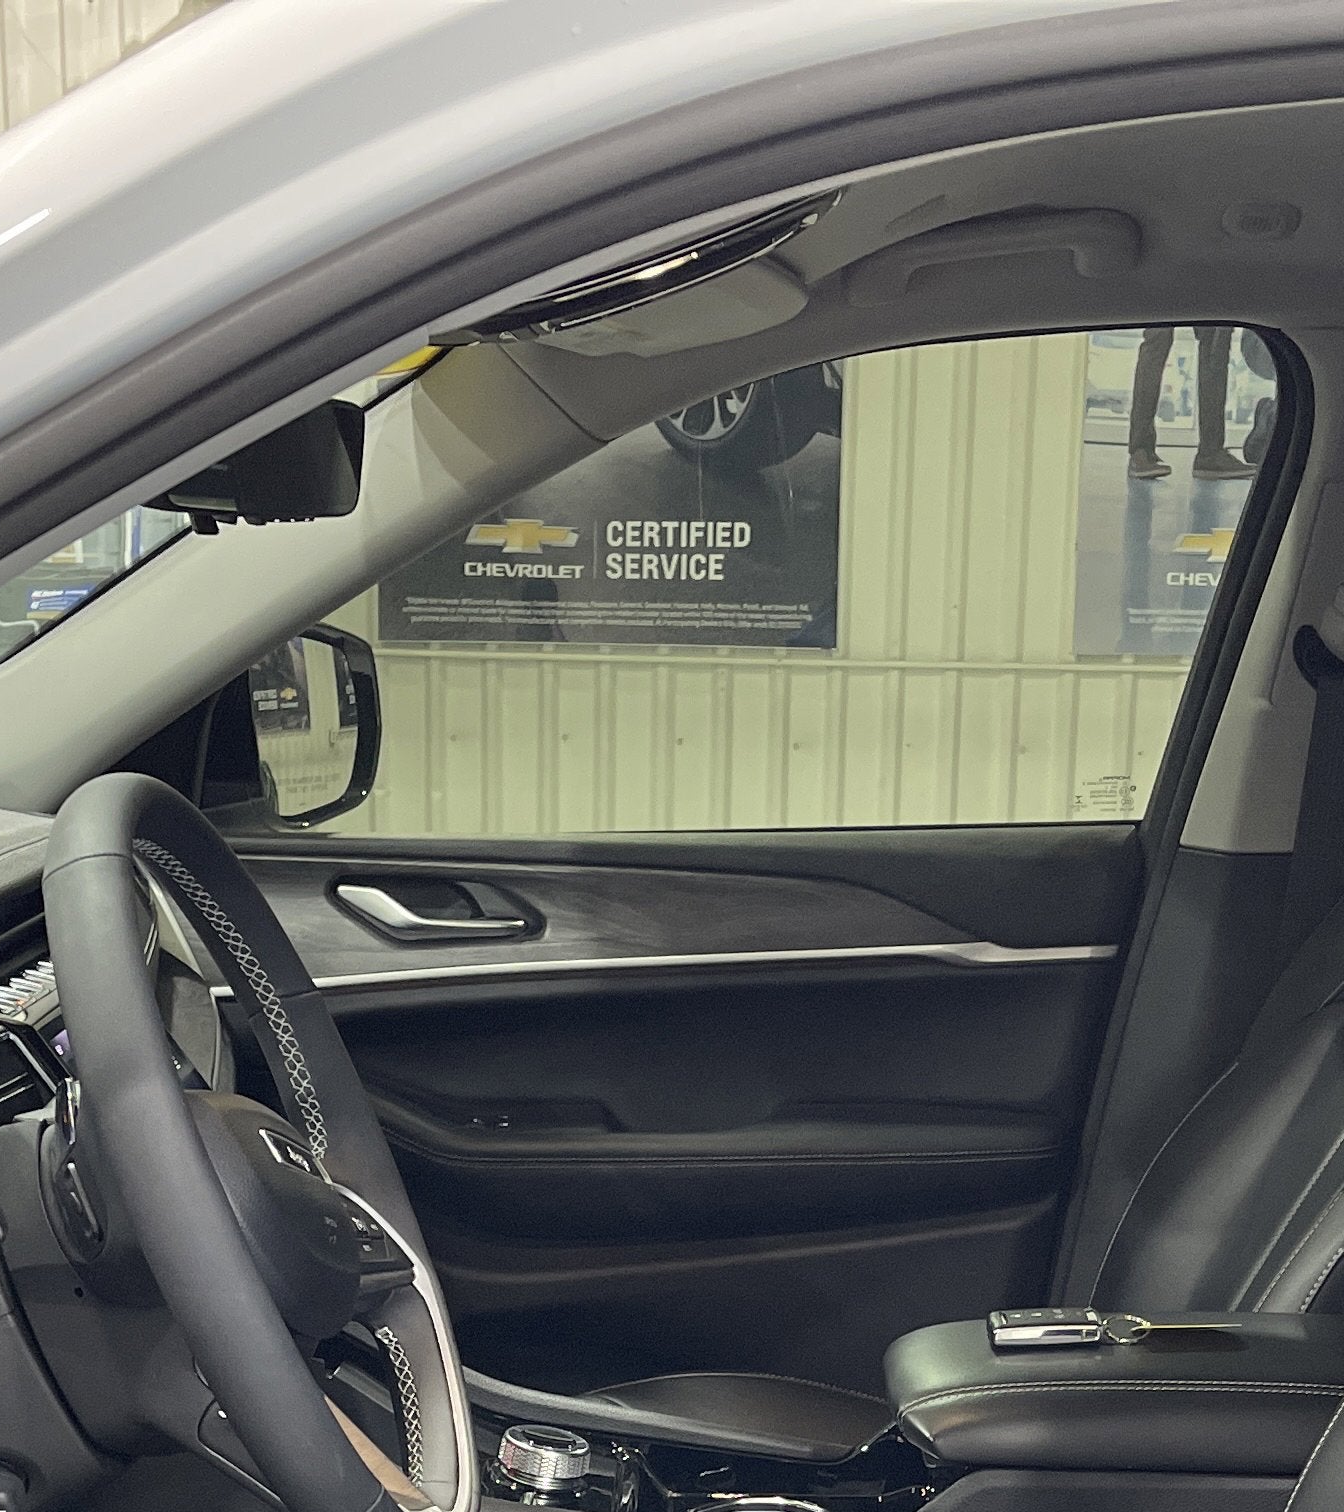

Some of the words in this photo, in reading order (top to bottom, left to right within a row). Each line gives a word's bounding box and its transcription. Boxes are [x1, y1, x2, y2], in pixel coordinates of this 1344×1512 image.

[606, 520, 752, 548] CERTIFIED
[463, 561, 584, 579] CHEVROLET
[605, 553, 725, 581] SERVICE
